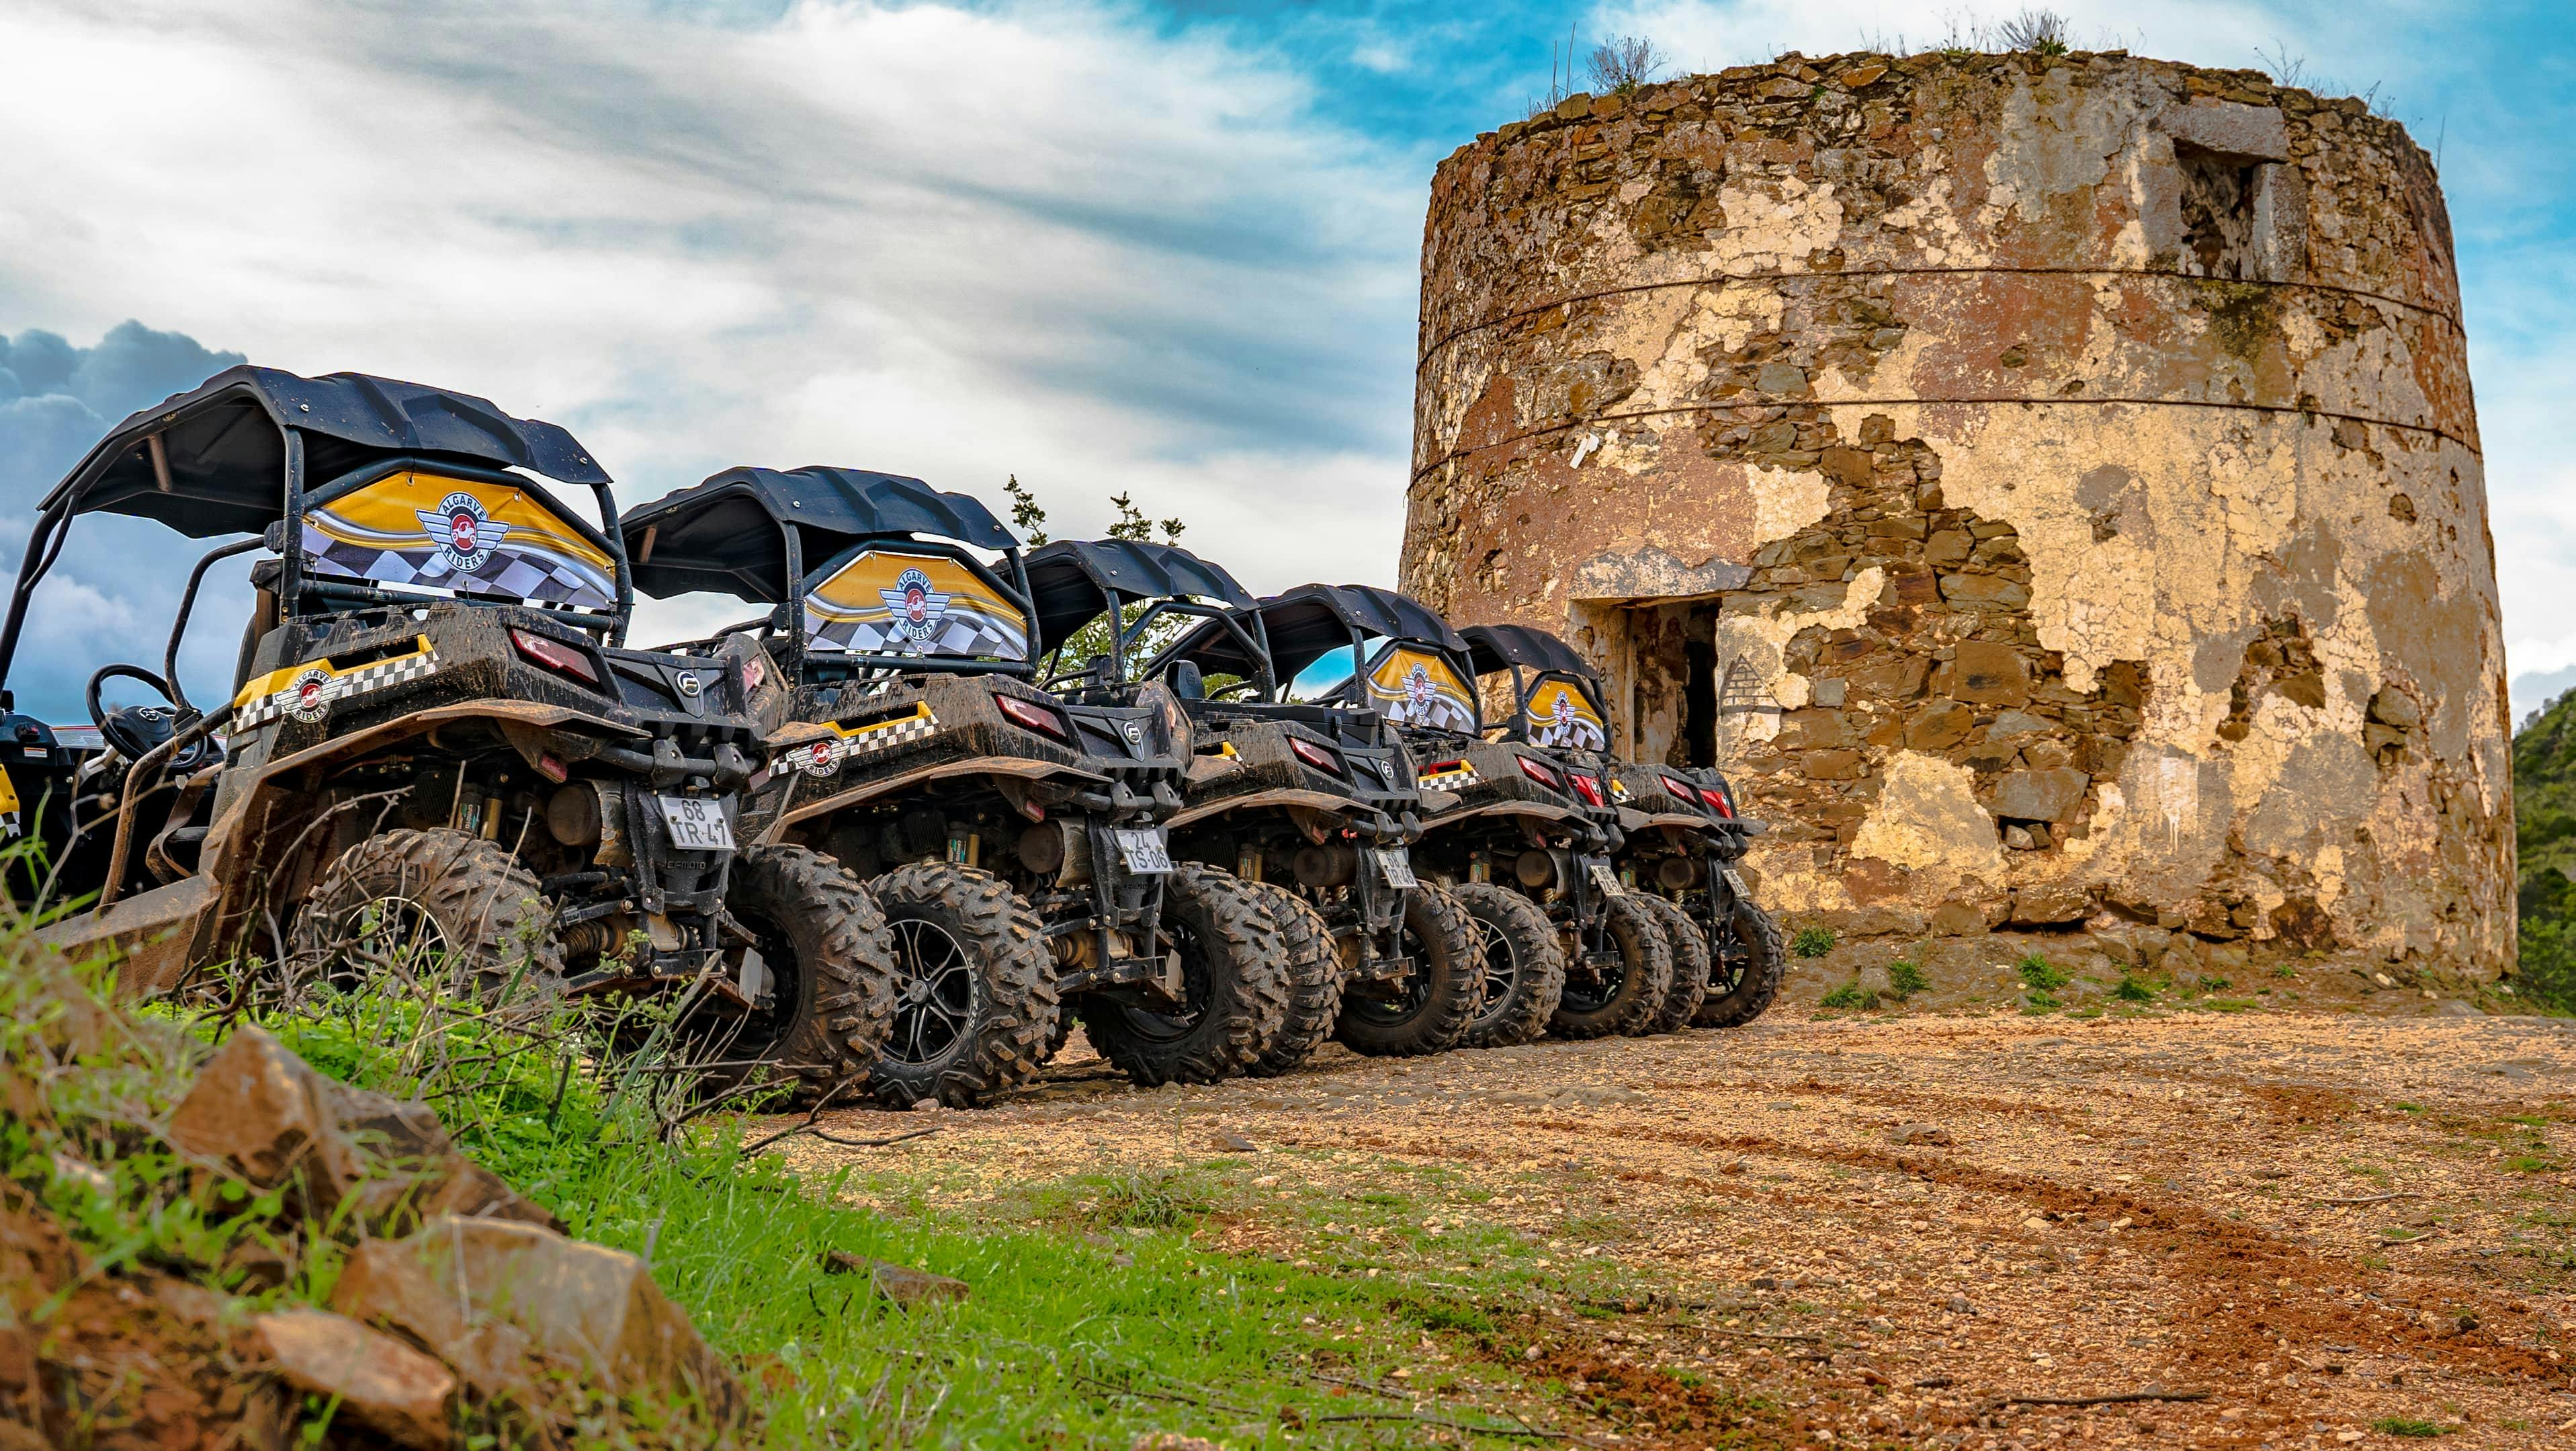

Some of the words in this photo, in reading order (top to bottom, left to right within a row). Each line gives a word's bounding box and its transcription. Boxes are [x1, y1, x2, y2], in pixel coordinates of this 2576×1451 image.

[442, 495, 485, 520] ALGARVE
[444, 547, 484, 569] RIDERS
[899, 572, 931, 591] ALGARVE
[902, 620, 933, 638] RIDERS
[295, 671, 330, 689] ALGARVE
[296, 703, 327, 720] RIDERS
[808, 759, 837, 774] RIDERS
[682, 800, 705, 821] 68
[1131, 832, 1151, 850] 24
[1386, 853, 1400, 868] 68
